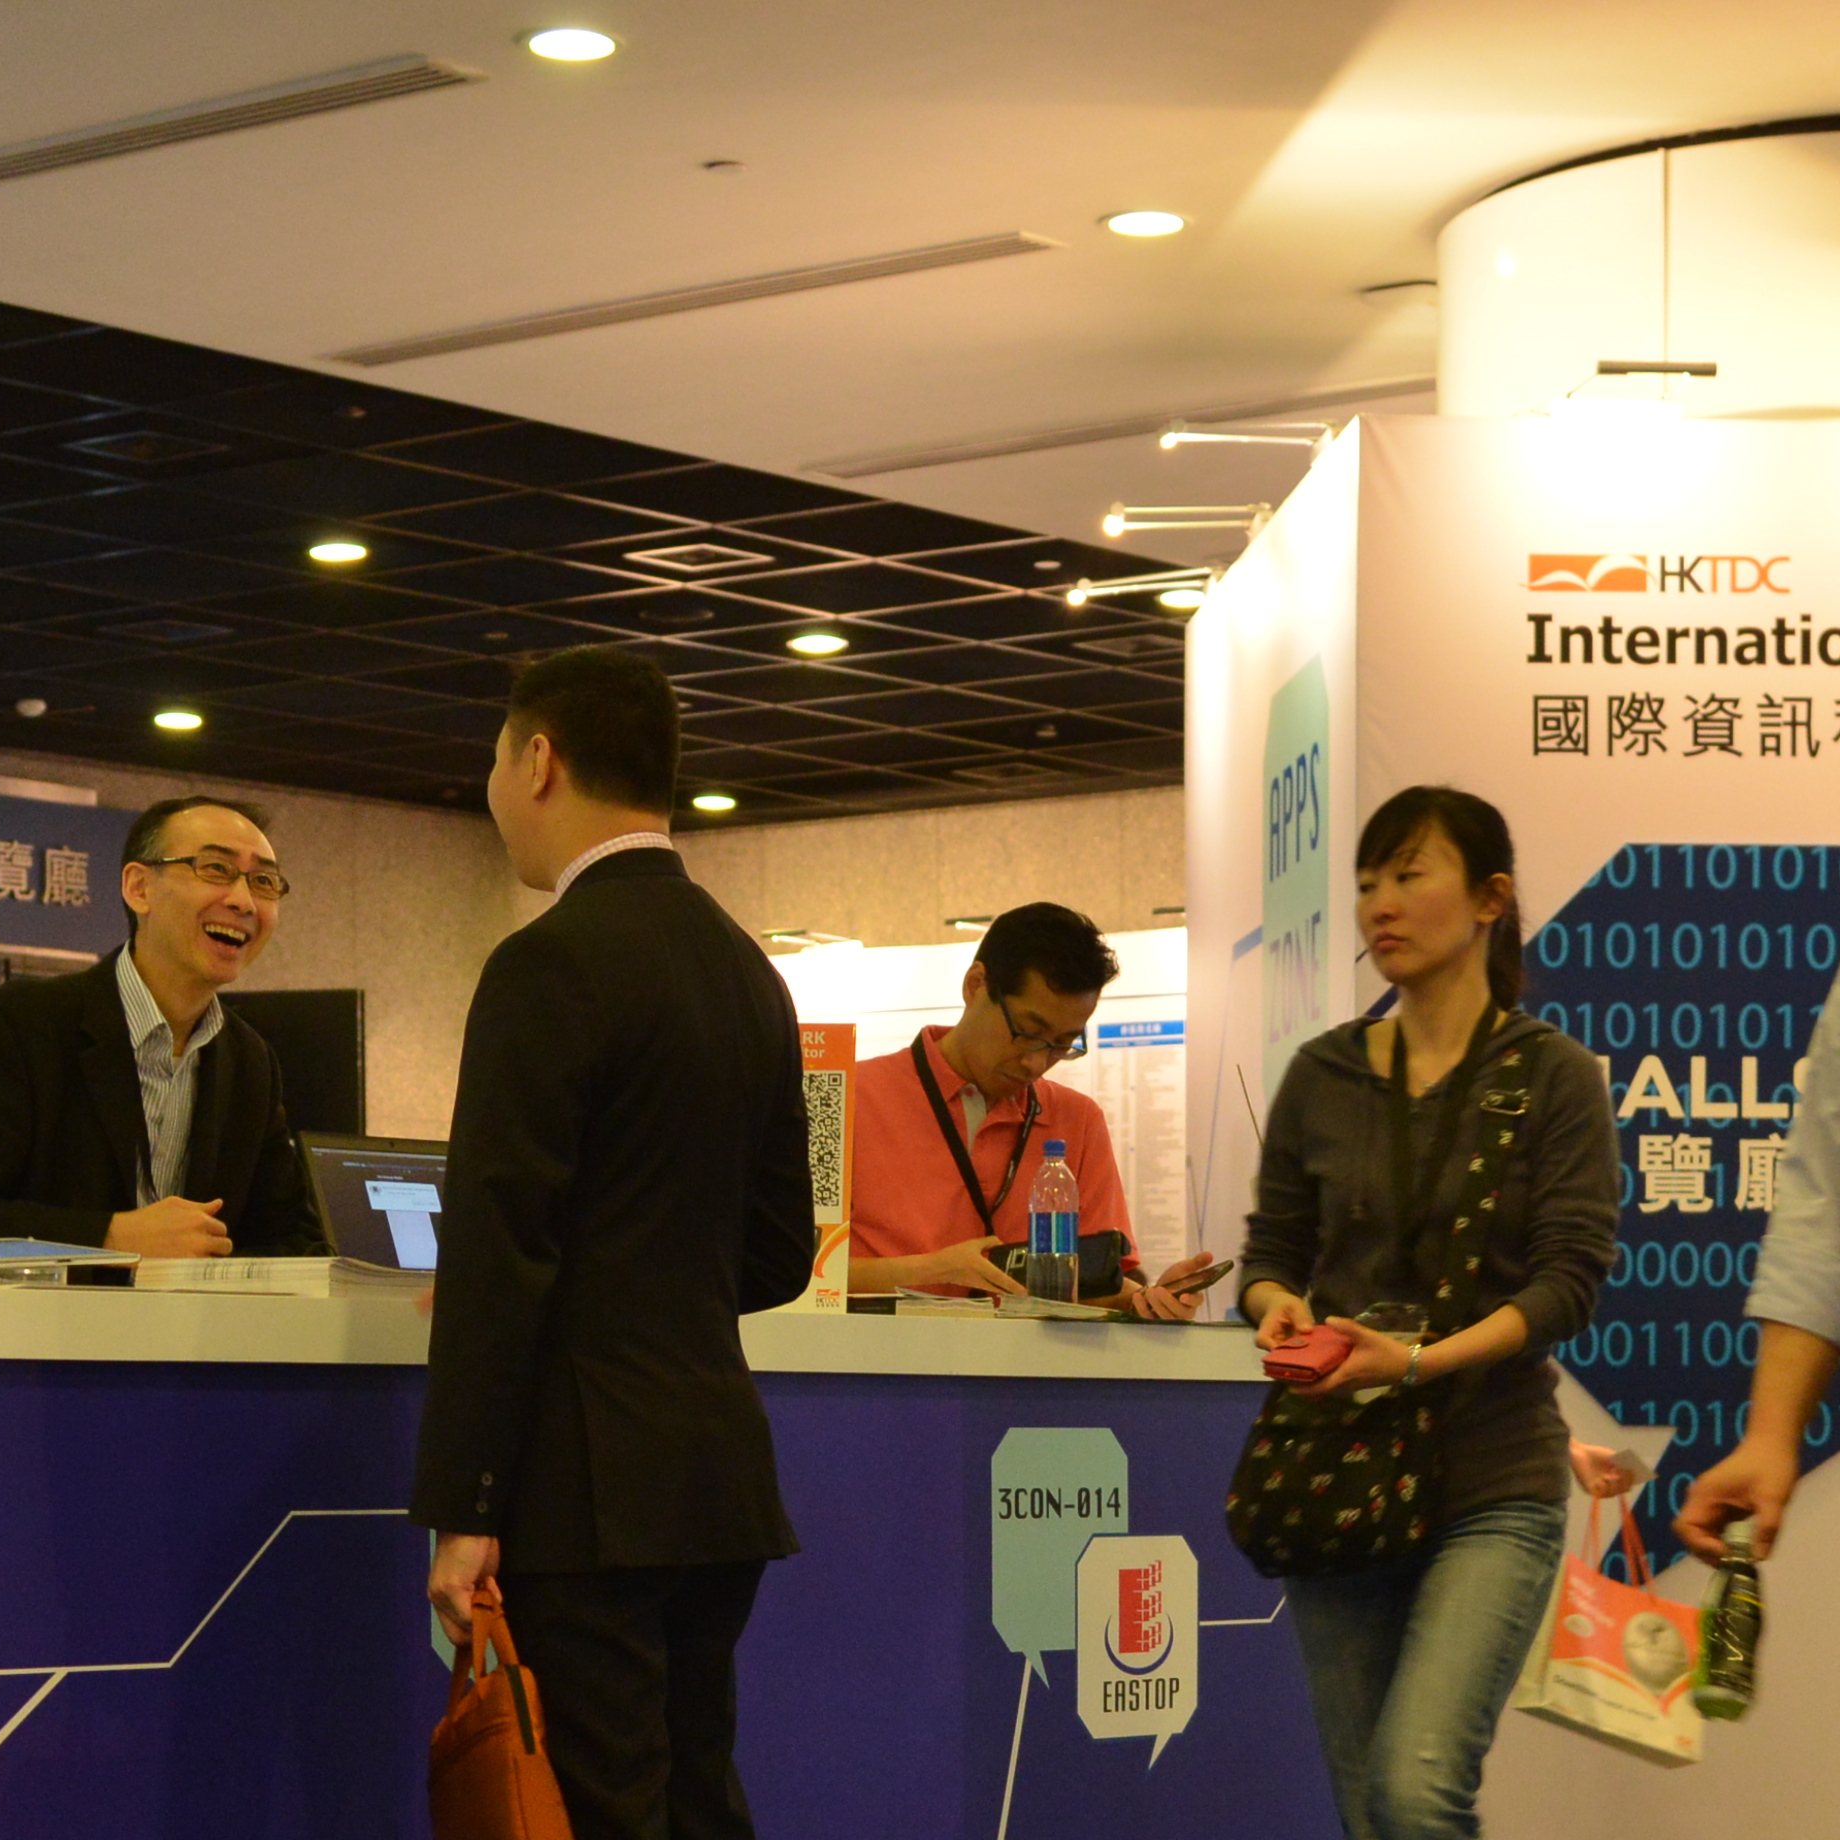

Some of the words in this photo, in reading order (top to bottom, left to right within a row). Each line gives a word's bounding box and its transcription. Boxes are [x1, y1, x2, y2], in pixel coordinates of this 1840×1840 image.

[1659, 555, 1791, 594] HKTDC
[1267, 741, 1321, 883] APPS
[1268, 910, 1321, 1044] ZONE
[997, 1487, 1122, 1520] 3CON-014
[1102, 1676, 1181, 1714] EASTOP
